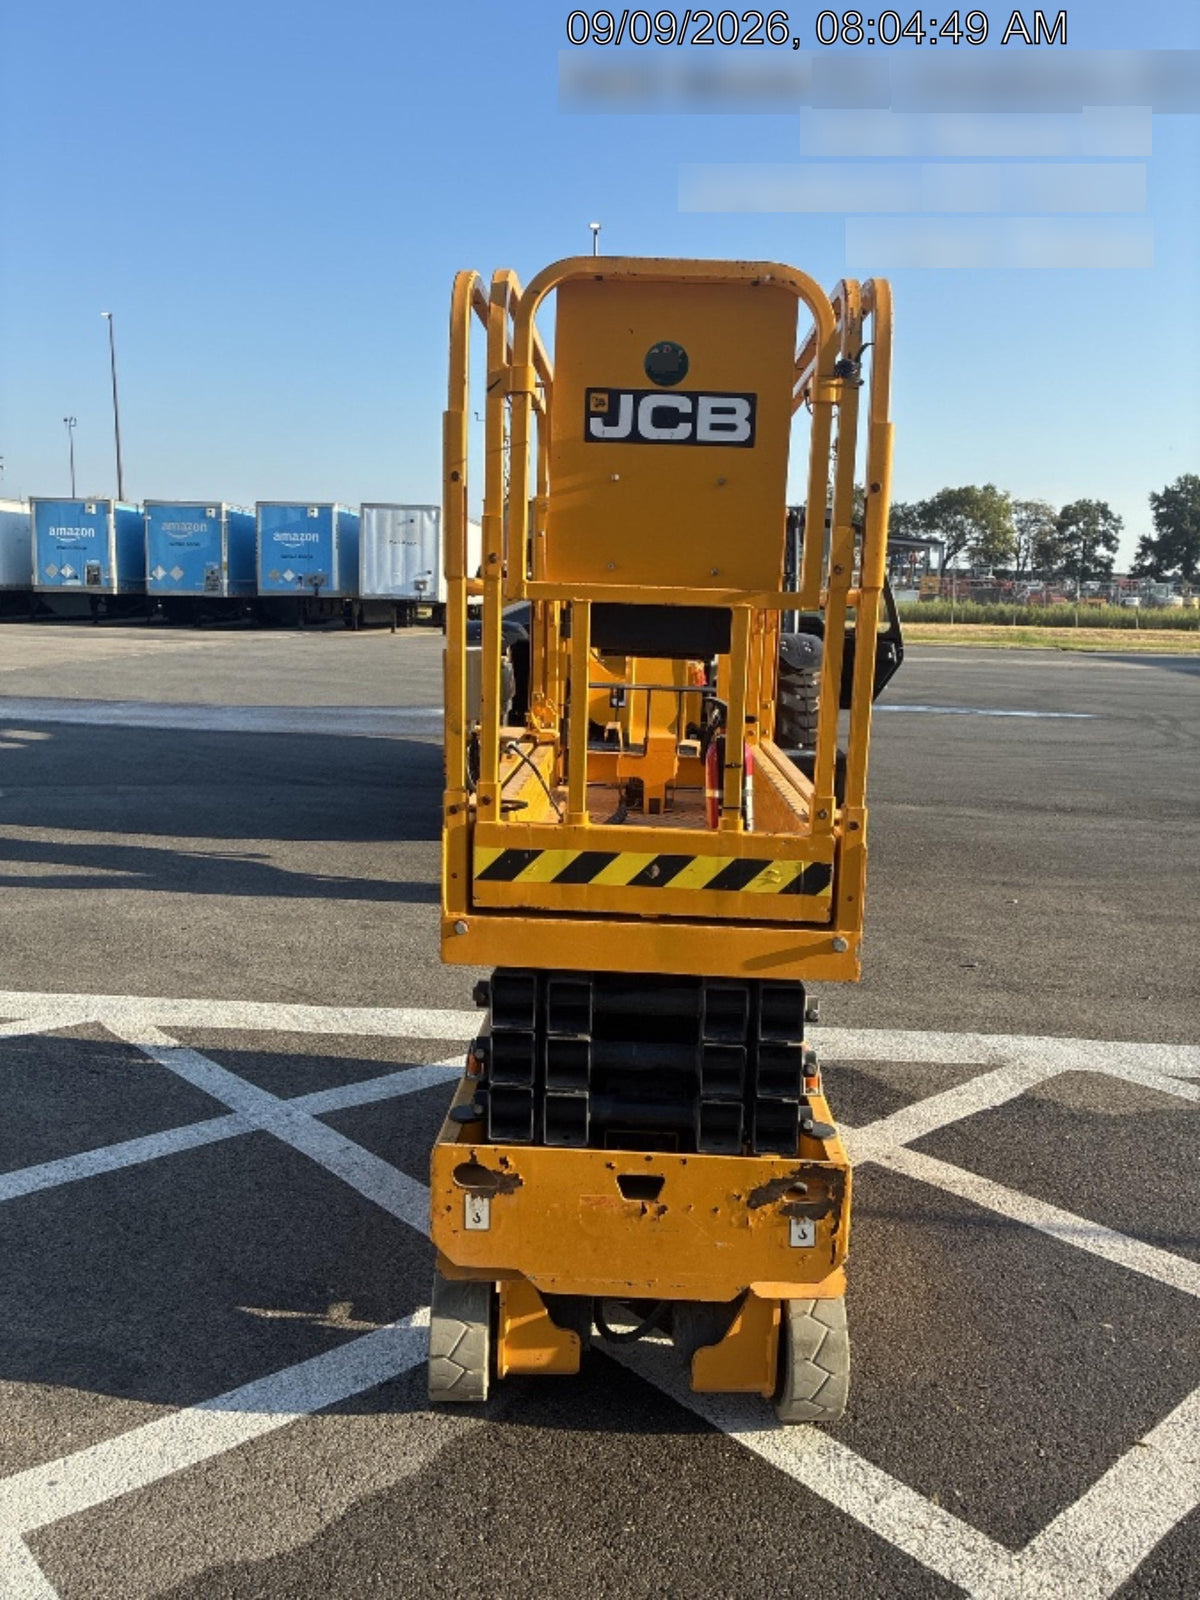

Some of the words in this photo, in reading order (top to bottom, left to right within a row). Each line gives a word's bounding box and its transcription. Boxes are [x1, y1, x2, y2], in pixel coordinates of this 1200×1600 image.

[590, 394, 752, 442] JCB
[49, 526, 95, 538] amazon
[161, 522, 207, 532] amazon
[272, 532, 319, 543] amazon
